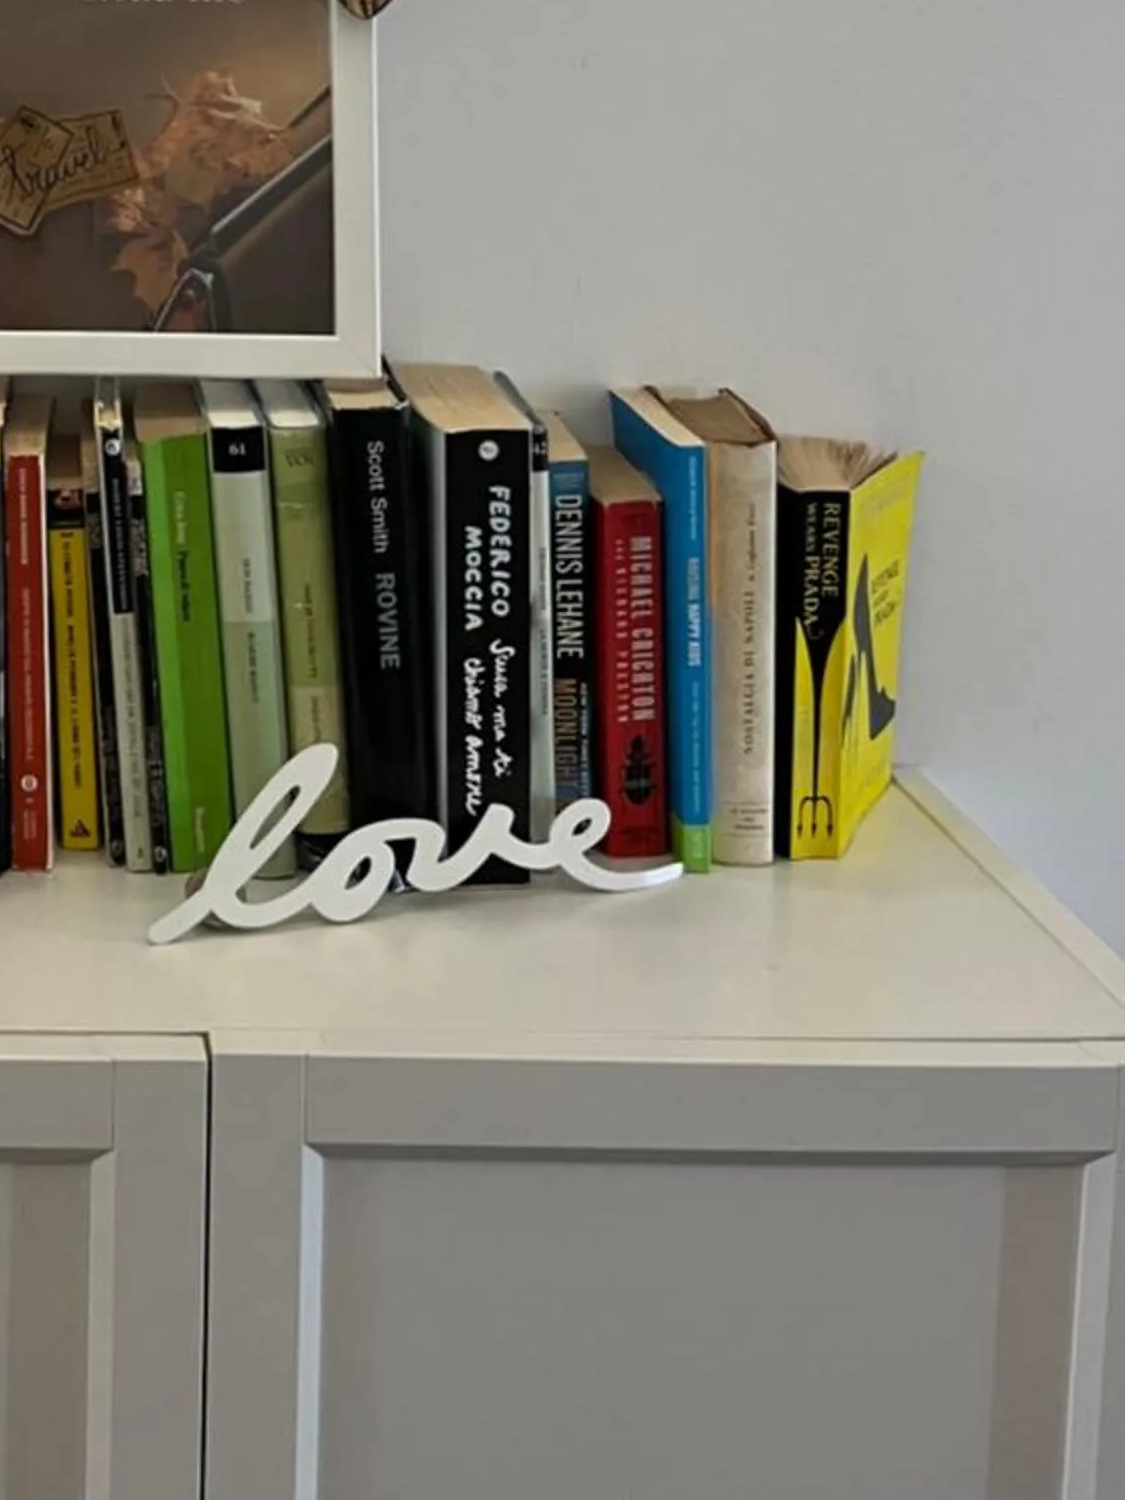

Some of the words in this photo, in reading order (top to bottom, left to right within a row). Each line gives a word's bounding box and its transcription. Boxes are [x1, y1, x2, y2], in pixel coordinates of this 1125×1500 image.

[366, 439, 386, 491] Scott
[369, 496, 390, 553] Smith
[490, 484, 512, 617] FEDERICO
[554, 493, 583, 574] DENNIS
[822, 502, 842, 598] REVENGE
[464, 525, 484, 632] MOCCIA
[554, 579, 583, 659] LEHANE
[631, 536, 653, 620] MICHAEL
[803, 555, 821, 631] PRADA
[375, 572, 401, 670] ROVINE
[632, 627, 656, 721] CRICHTON
[492, 704, 507, 742] ma
[147, 742, 683, 946] love
